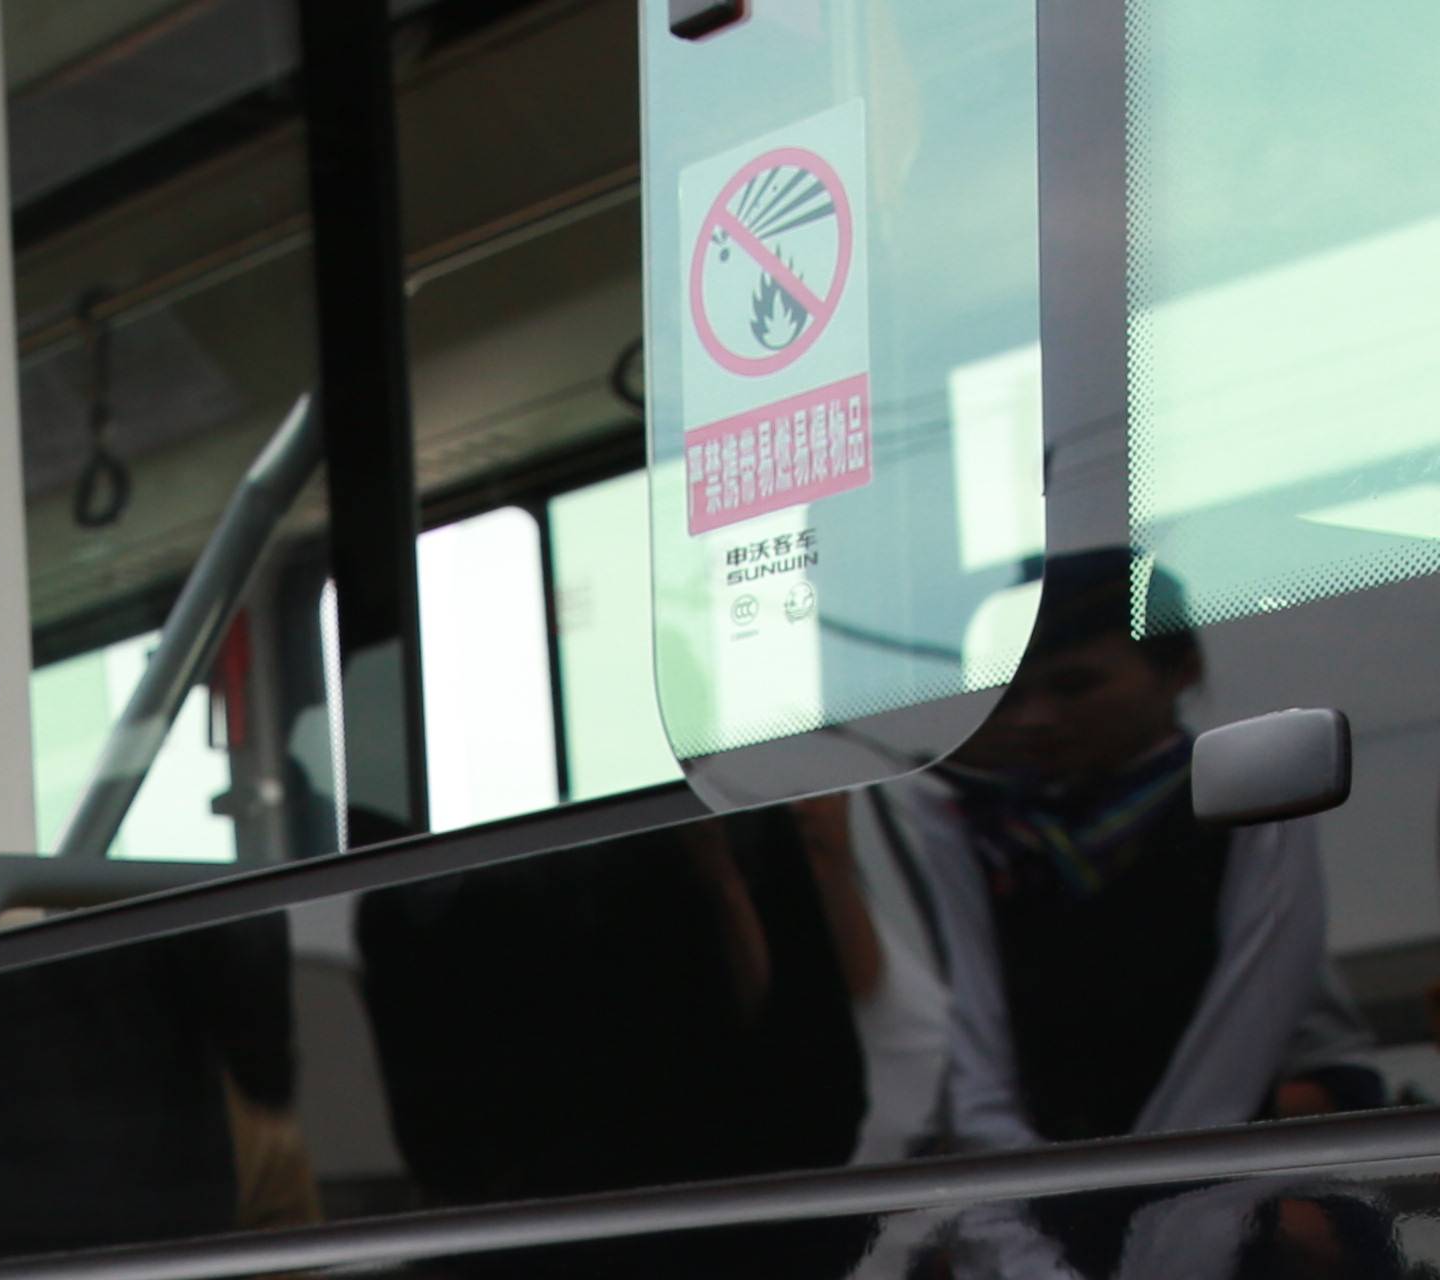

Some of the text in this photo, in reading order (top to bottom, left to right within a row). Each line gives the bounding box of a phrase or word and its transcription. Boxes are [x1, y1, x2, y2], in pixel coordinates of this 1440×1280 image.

[726, 528, 817, 567] 申沃客车
[726, 551, 820, 586] SUNWIN
